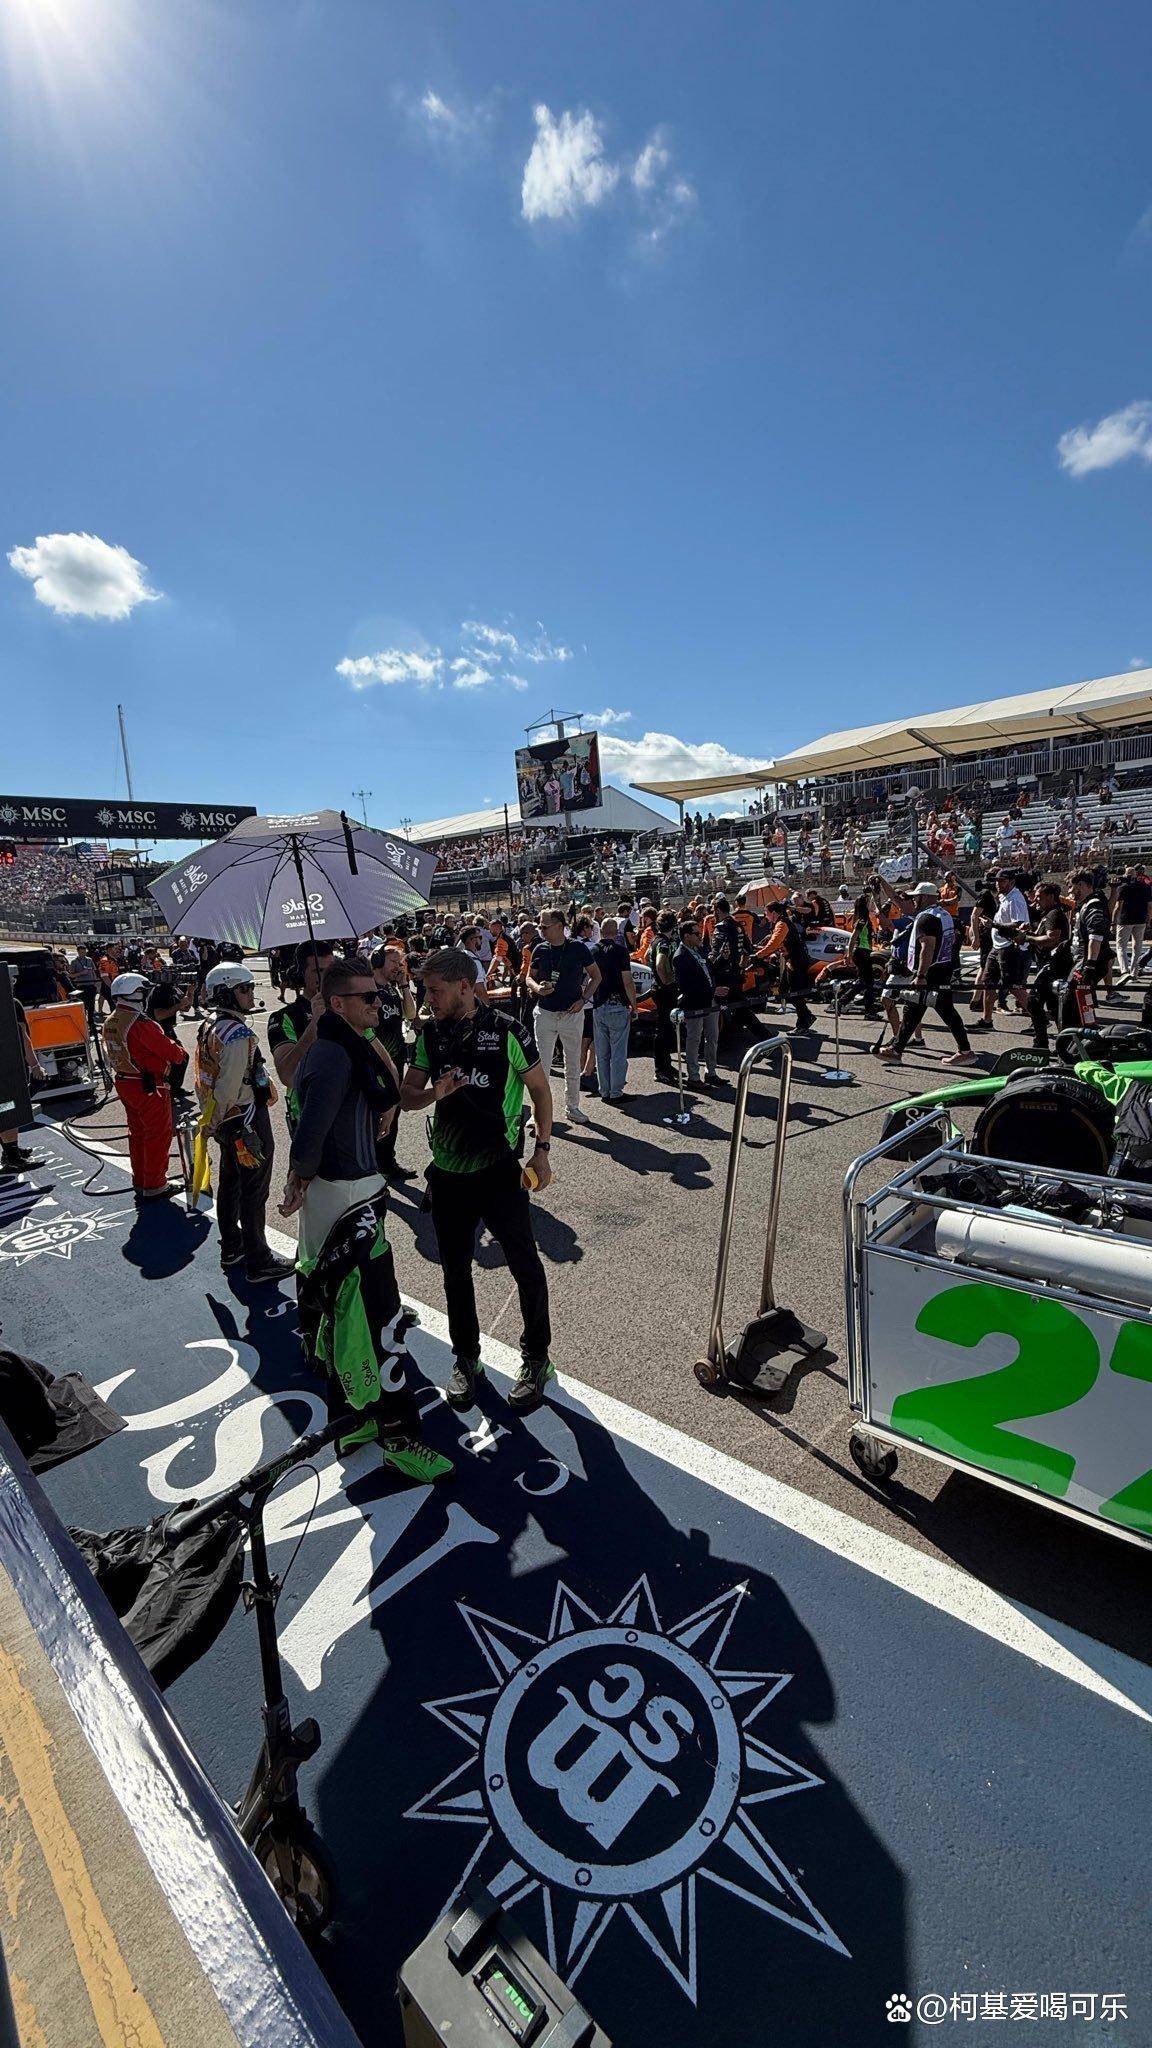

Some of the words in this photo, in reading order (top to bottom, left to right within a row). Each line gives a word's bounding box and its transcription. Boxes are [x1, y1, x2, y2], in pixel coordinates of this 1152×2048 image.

[20, 806, 67, 821] MSC
[117, 810, 156, 824] MSC
[199, 812, 237, 826] MSC
[477, 1030, 500, 1042] Stake
[1010, 1051, 1044, 1064] PicPay
